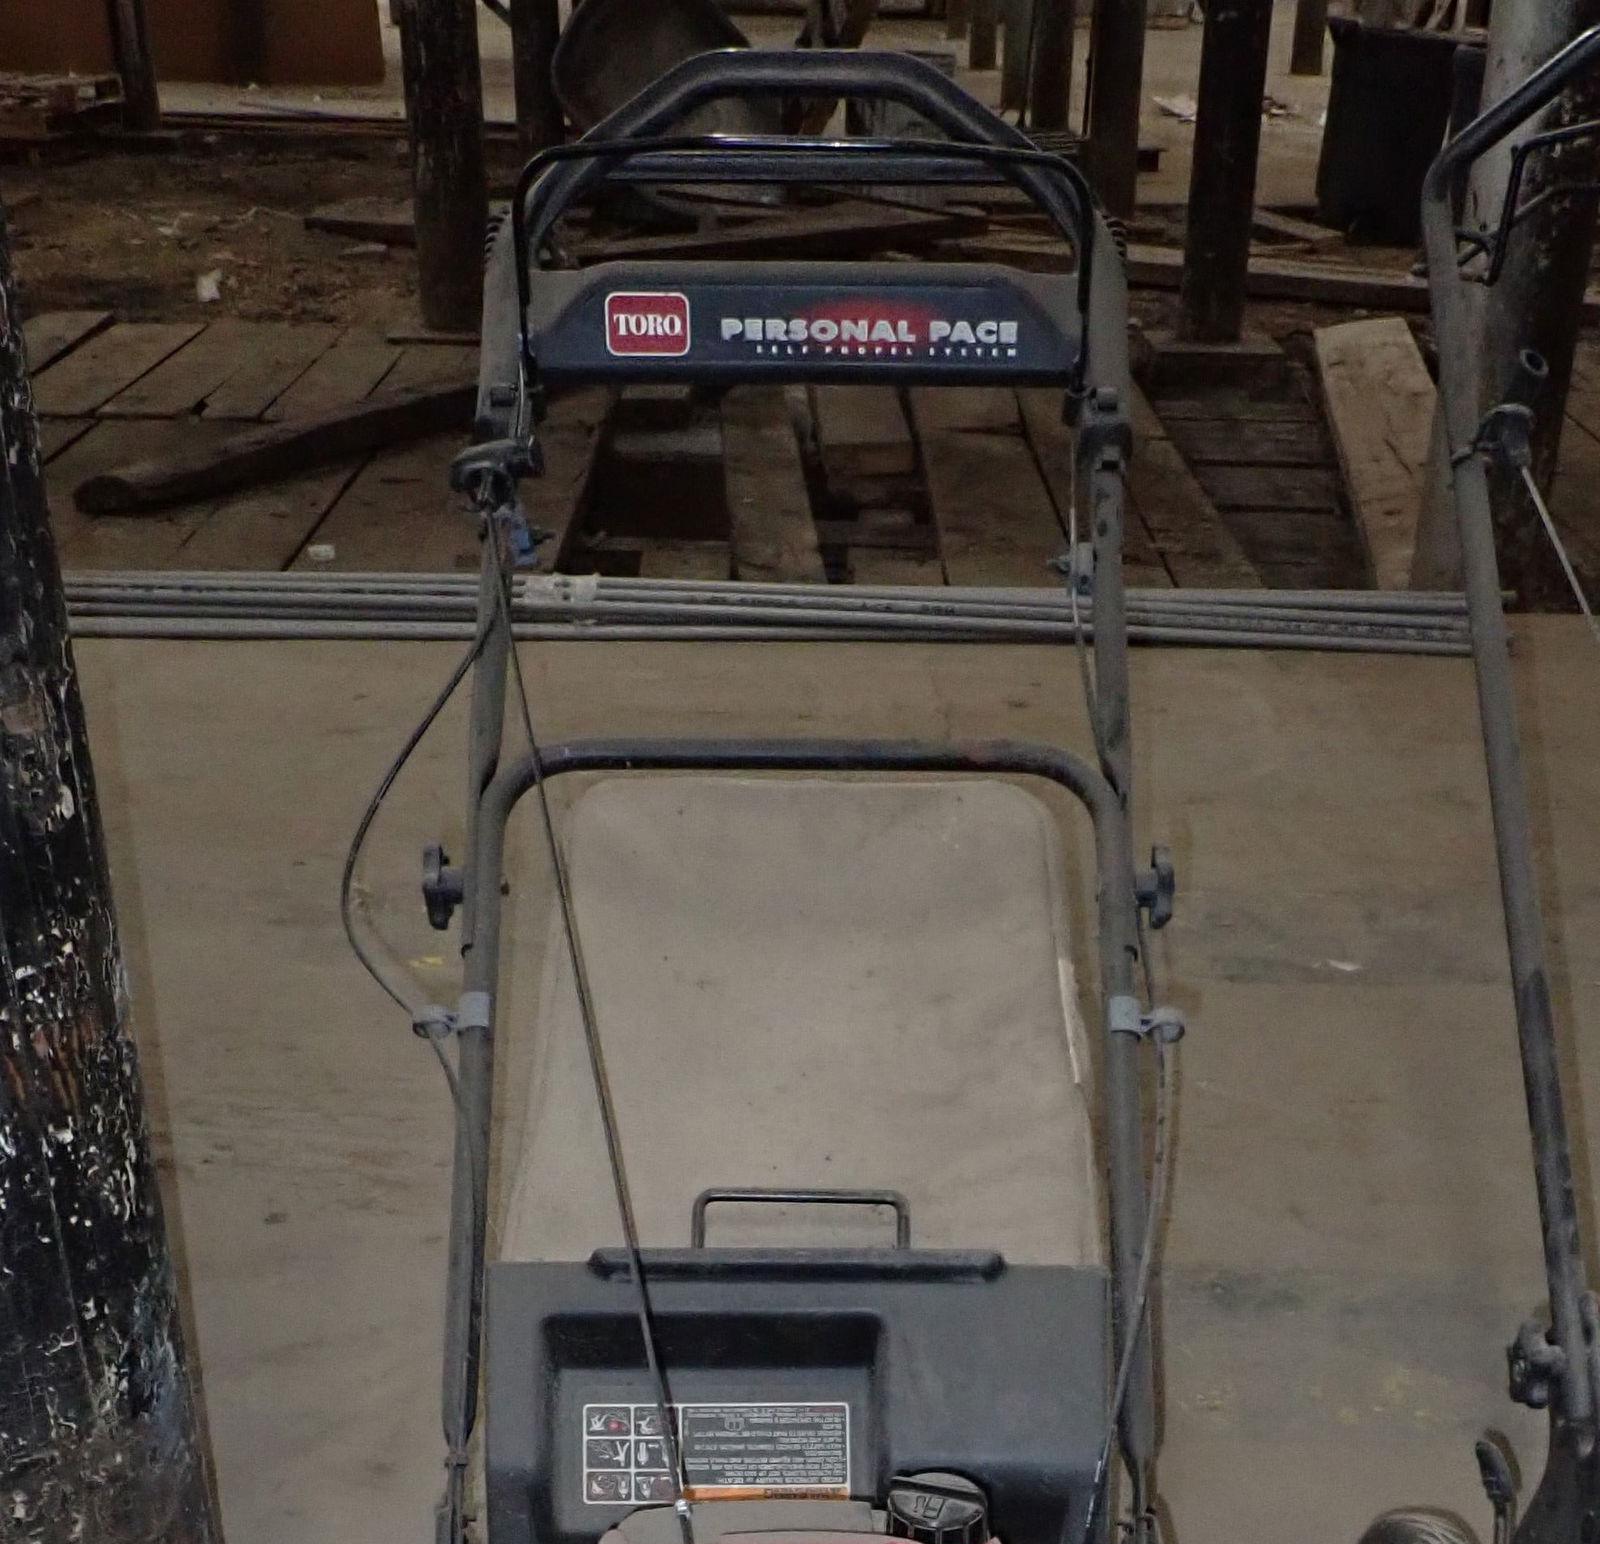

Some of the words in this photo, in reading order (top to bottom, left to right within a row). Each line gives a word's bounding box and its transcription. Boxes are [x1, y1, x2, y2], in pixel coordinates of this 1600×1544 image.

[613, 313, 682, 337] TORO
[721, 318, 916, 343] PERSONAL
[929, 320, 1018, 344] PACE
